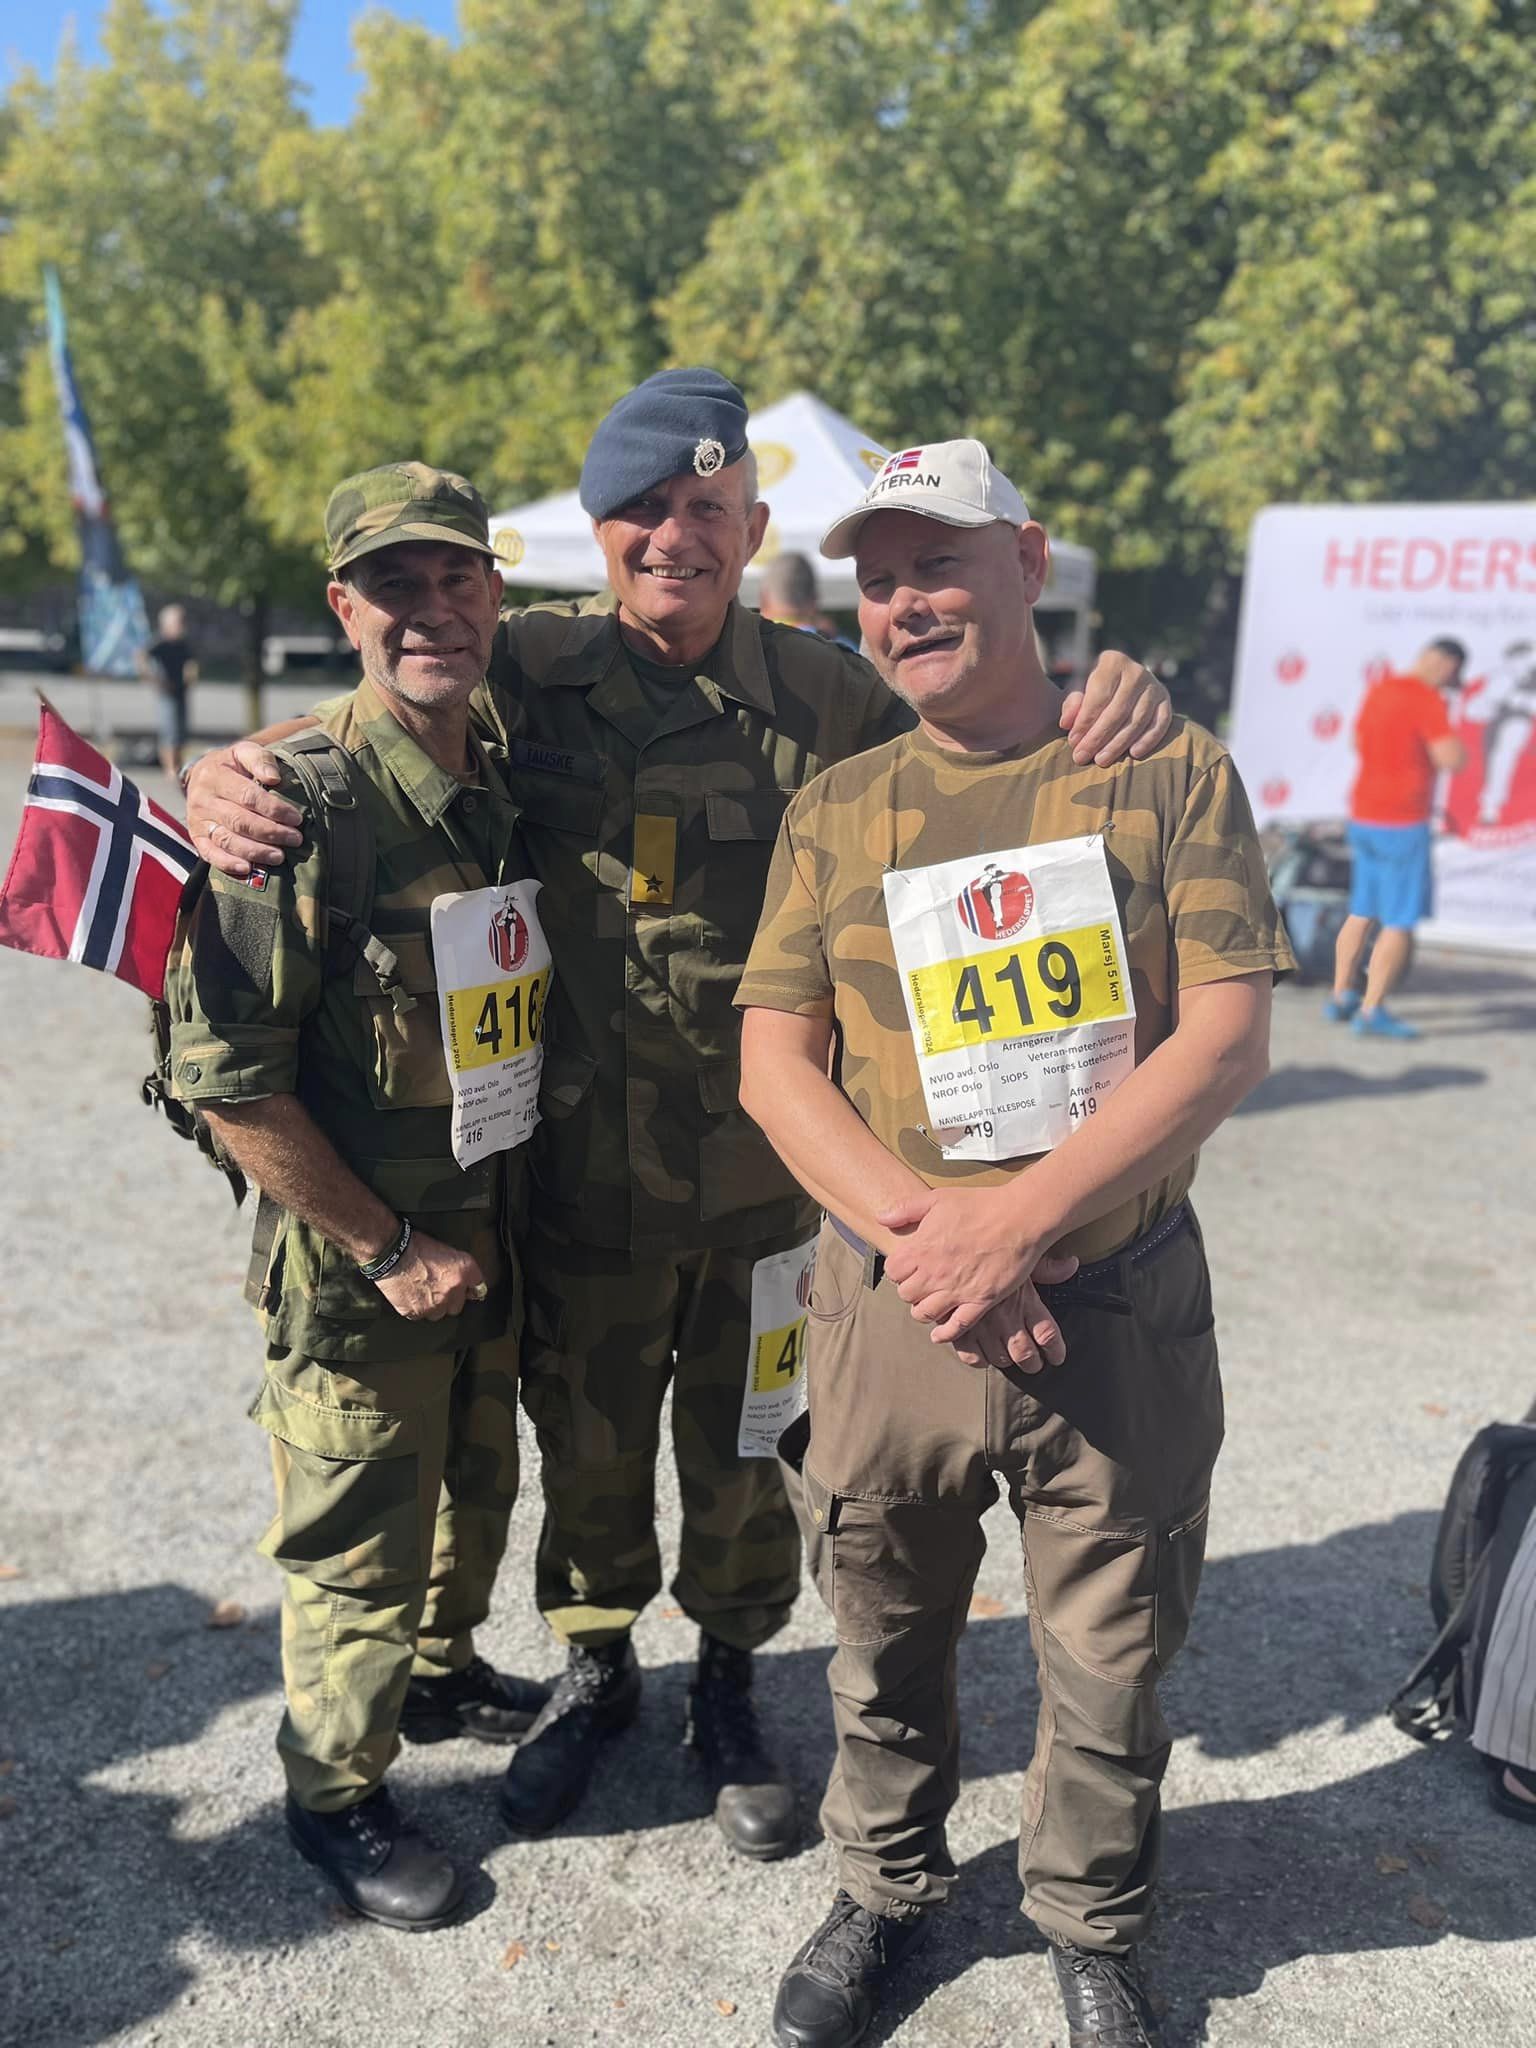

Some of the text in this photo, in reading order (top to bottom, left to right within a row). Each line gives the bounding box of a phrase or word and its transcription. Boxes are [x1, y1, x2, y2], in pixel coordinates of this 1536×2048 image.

[1100, 929, 1120, 1002] Marsj 5 km
[952, 942, 1082, 1035] 419
[474, 978, 541, 1055] 416
[923, 1030, 934, 1053] 2024
[1002, 1034, 1055, 1052] Arrangører
[1042, 1046, 1128, 1076] Norges Lotteforbund
[487, 1080, 500, 1089] Oslo
[929, 1061, 1000, 1085] NVIO avd. Oslo
[1000, 1071, 1029, 1085] SIOPS
[932, 1081, 983, 1100] NROF Oslo
[1069, 1080, 1111, 1098] After Run
[938, 1109, 984, 1127] NAVNELAPP
[984, 1107, 996, 1118] TIL
[996, 1098, 1037, 1115] KLESPOSE
[1068, 1097, 1098, 1120] 419
[466, 1127, 483, 1145] 416
[963, 1120, 995, 1138] 419
